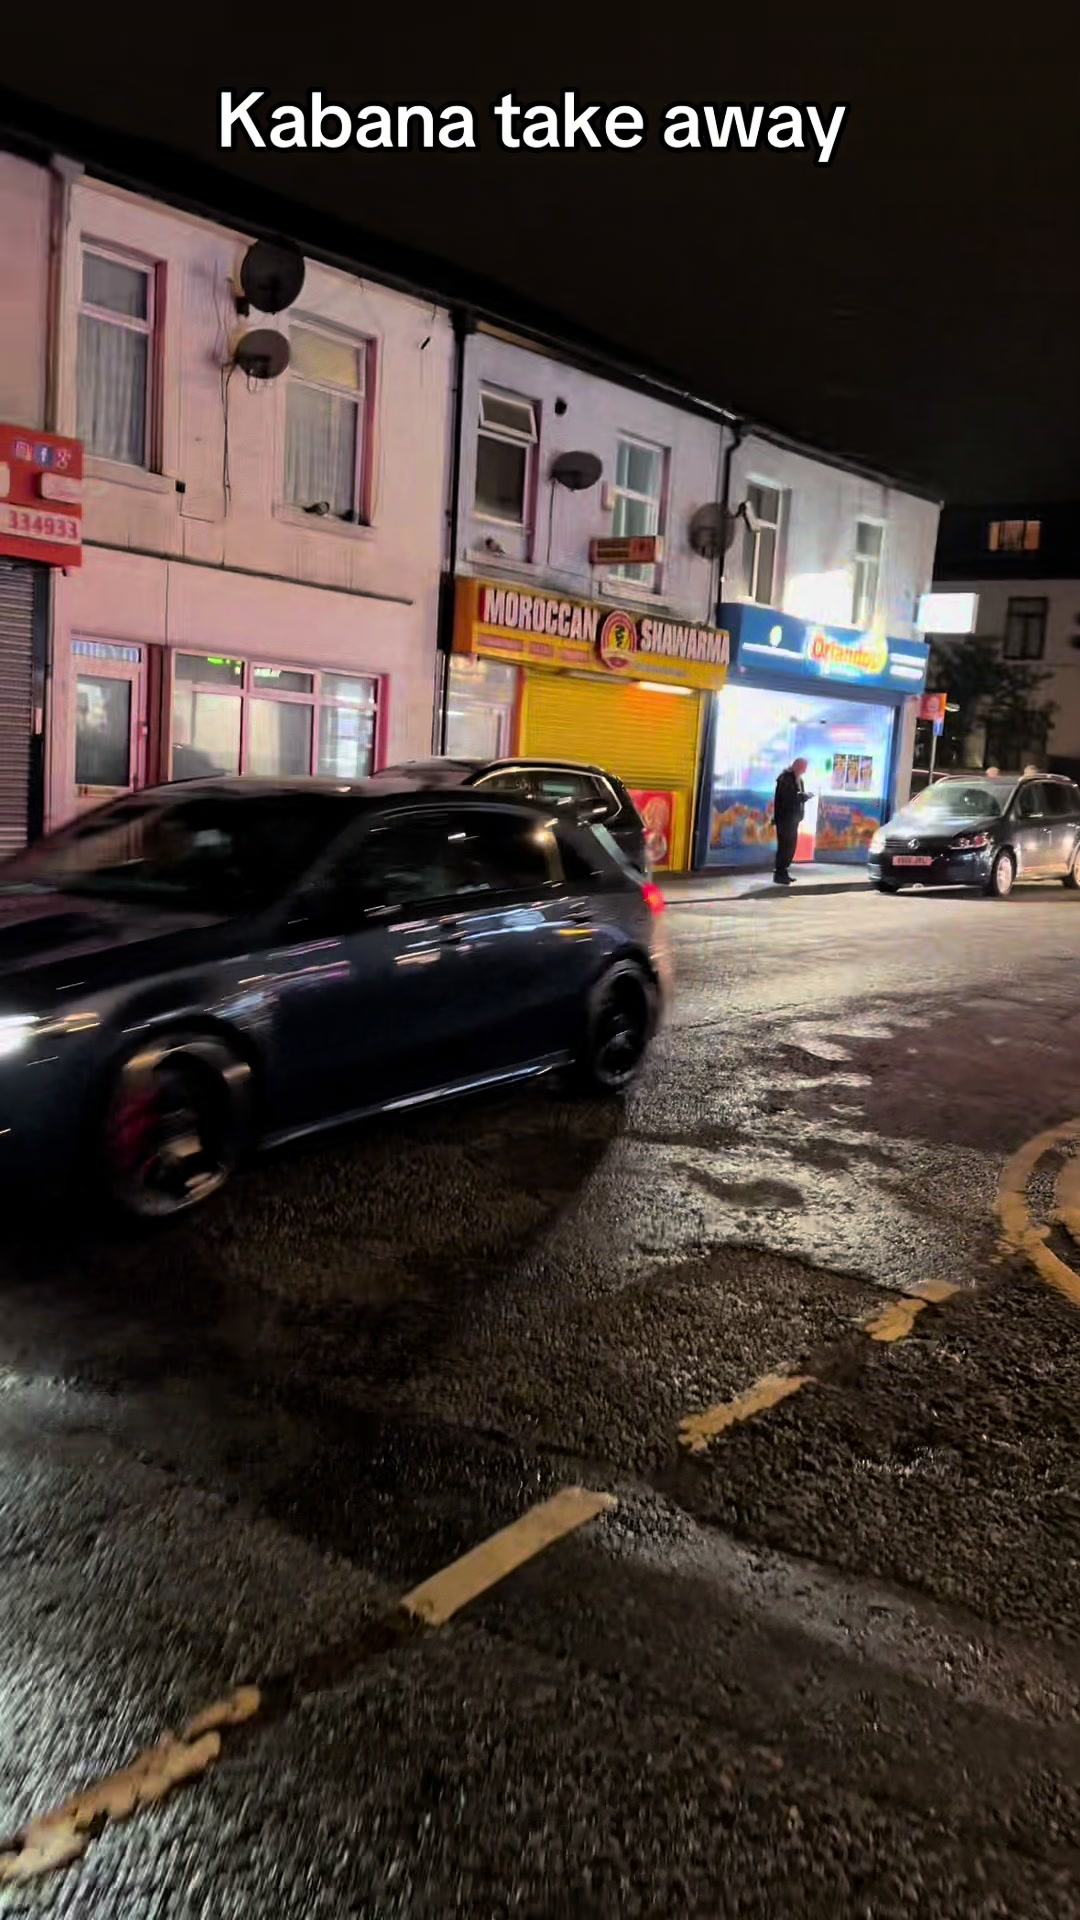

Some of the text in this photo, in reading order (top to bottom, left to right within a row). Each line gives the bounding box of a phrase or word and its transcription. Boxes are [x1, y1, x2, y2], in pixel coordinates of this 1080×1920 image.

[8, 510, 79, 540] 334933
[483, 587, 730, 665] MOROCCAN SHAWARMA
